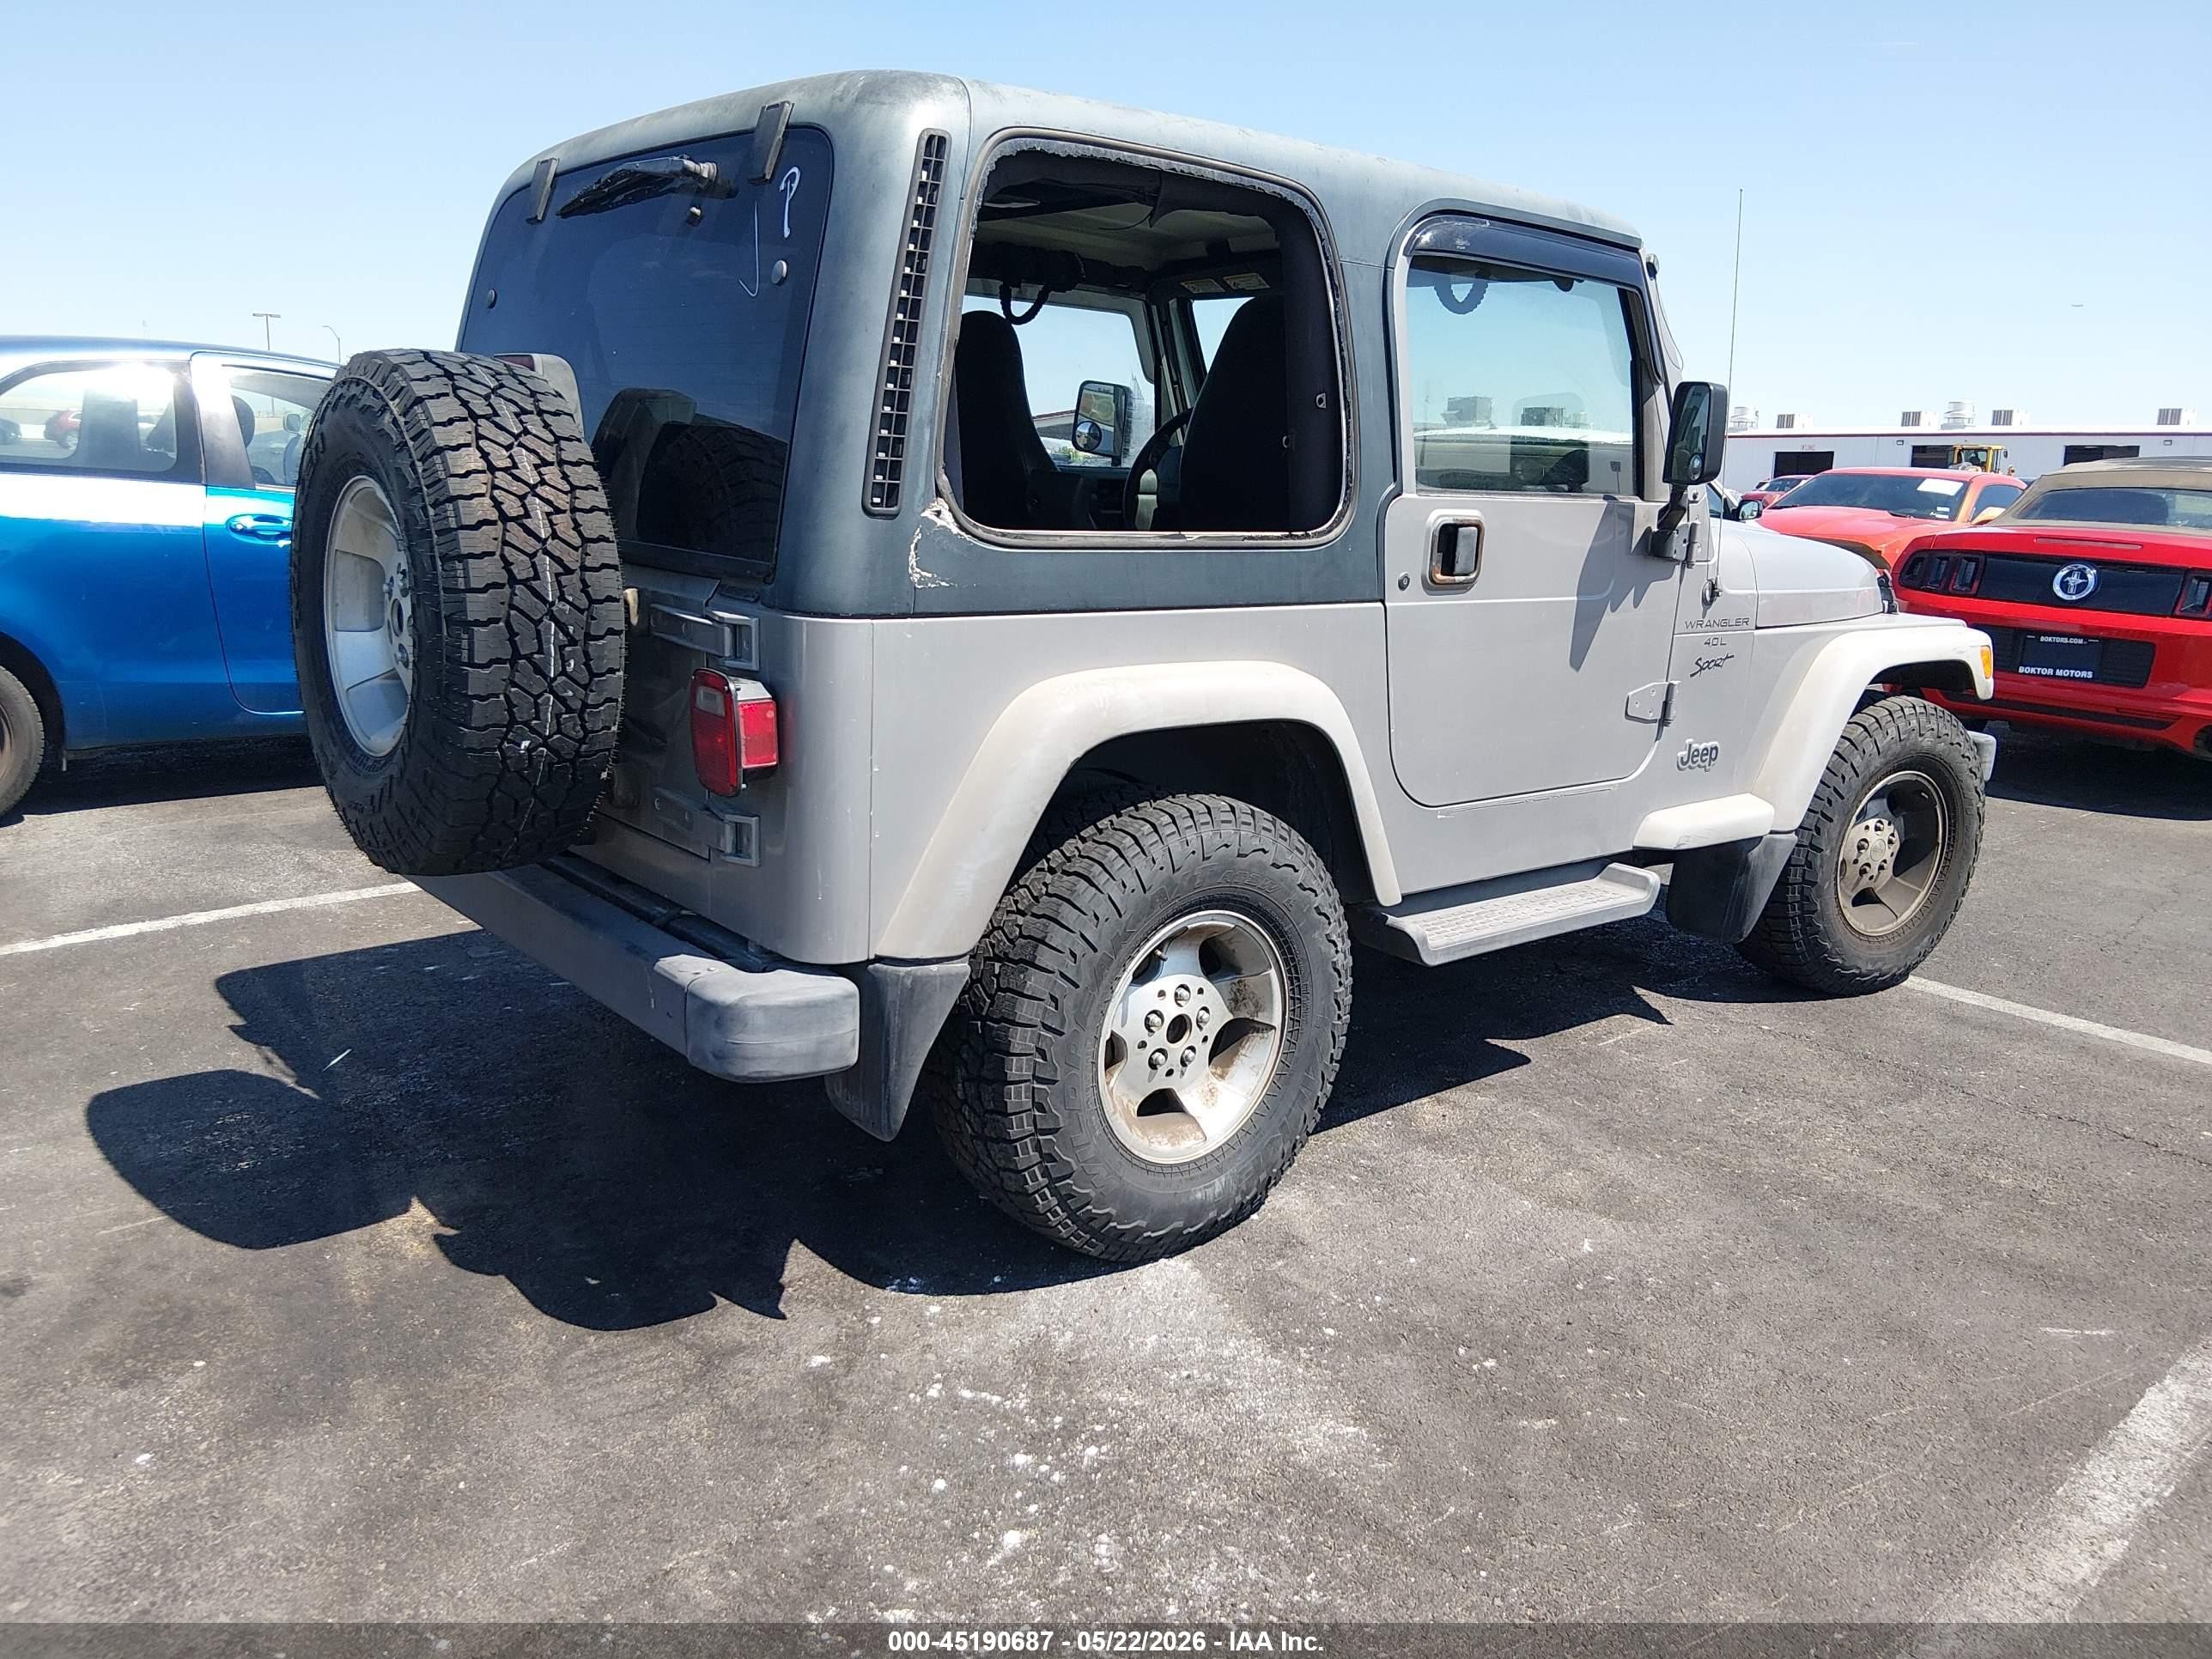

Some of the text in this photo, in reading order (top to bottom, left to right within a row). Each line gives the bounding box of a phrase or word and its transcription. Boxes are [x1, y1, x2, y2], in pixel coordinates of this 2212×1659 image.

[1685, 617, 1750, 629] WRANGLER
[2039, 635, 2084, 645] BOKTORS.COM
[2018, 665, 2094, 679] BOKTOR MOTORS
[1679, 741, 1719, 769] Jeep
